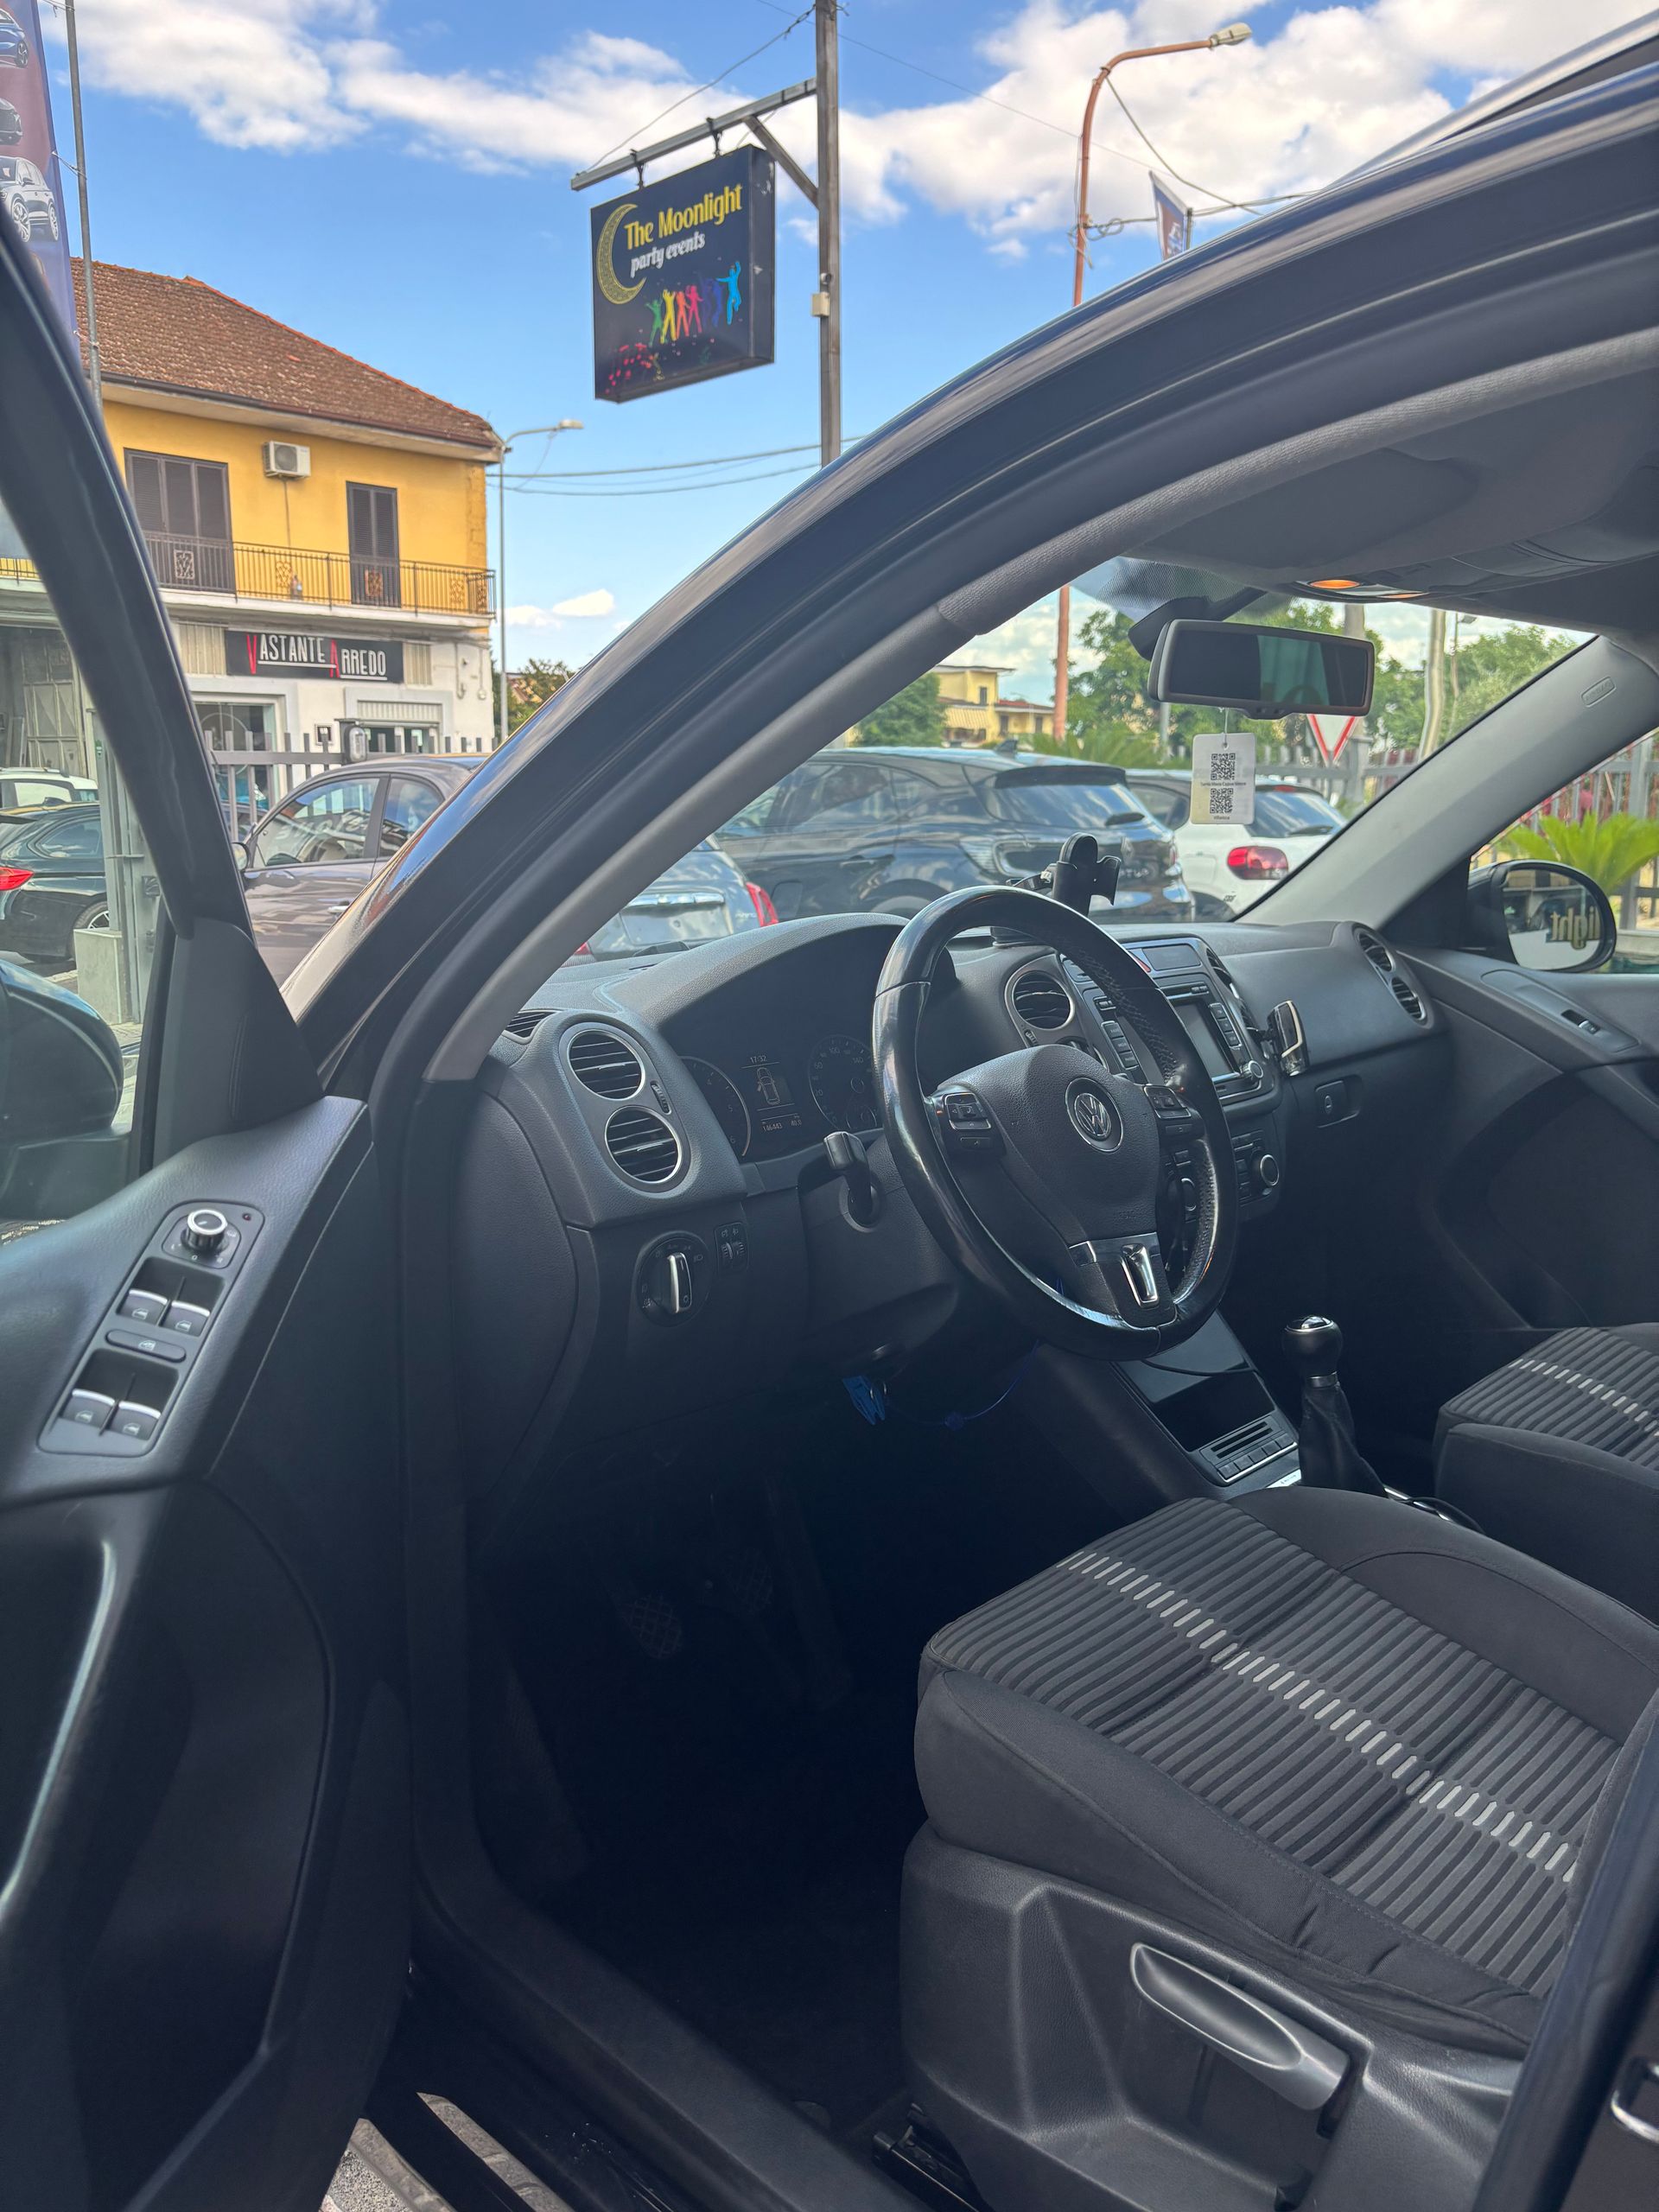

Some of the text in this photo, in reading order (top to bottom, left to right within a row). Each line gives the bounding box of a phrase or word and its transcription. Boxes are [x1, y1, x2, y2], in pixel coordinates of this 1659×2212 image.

[624, 184, 743, 250] The Moonlight
[630, 232, 705, 278] party events
[246, 633, 387, 678] VASTANTE ARREDO
